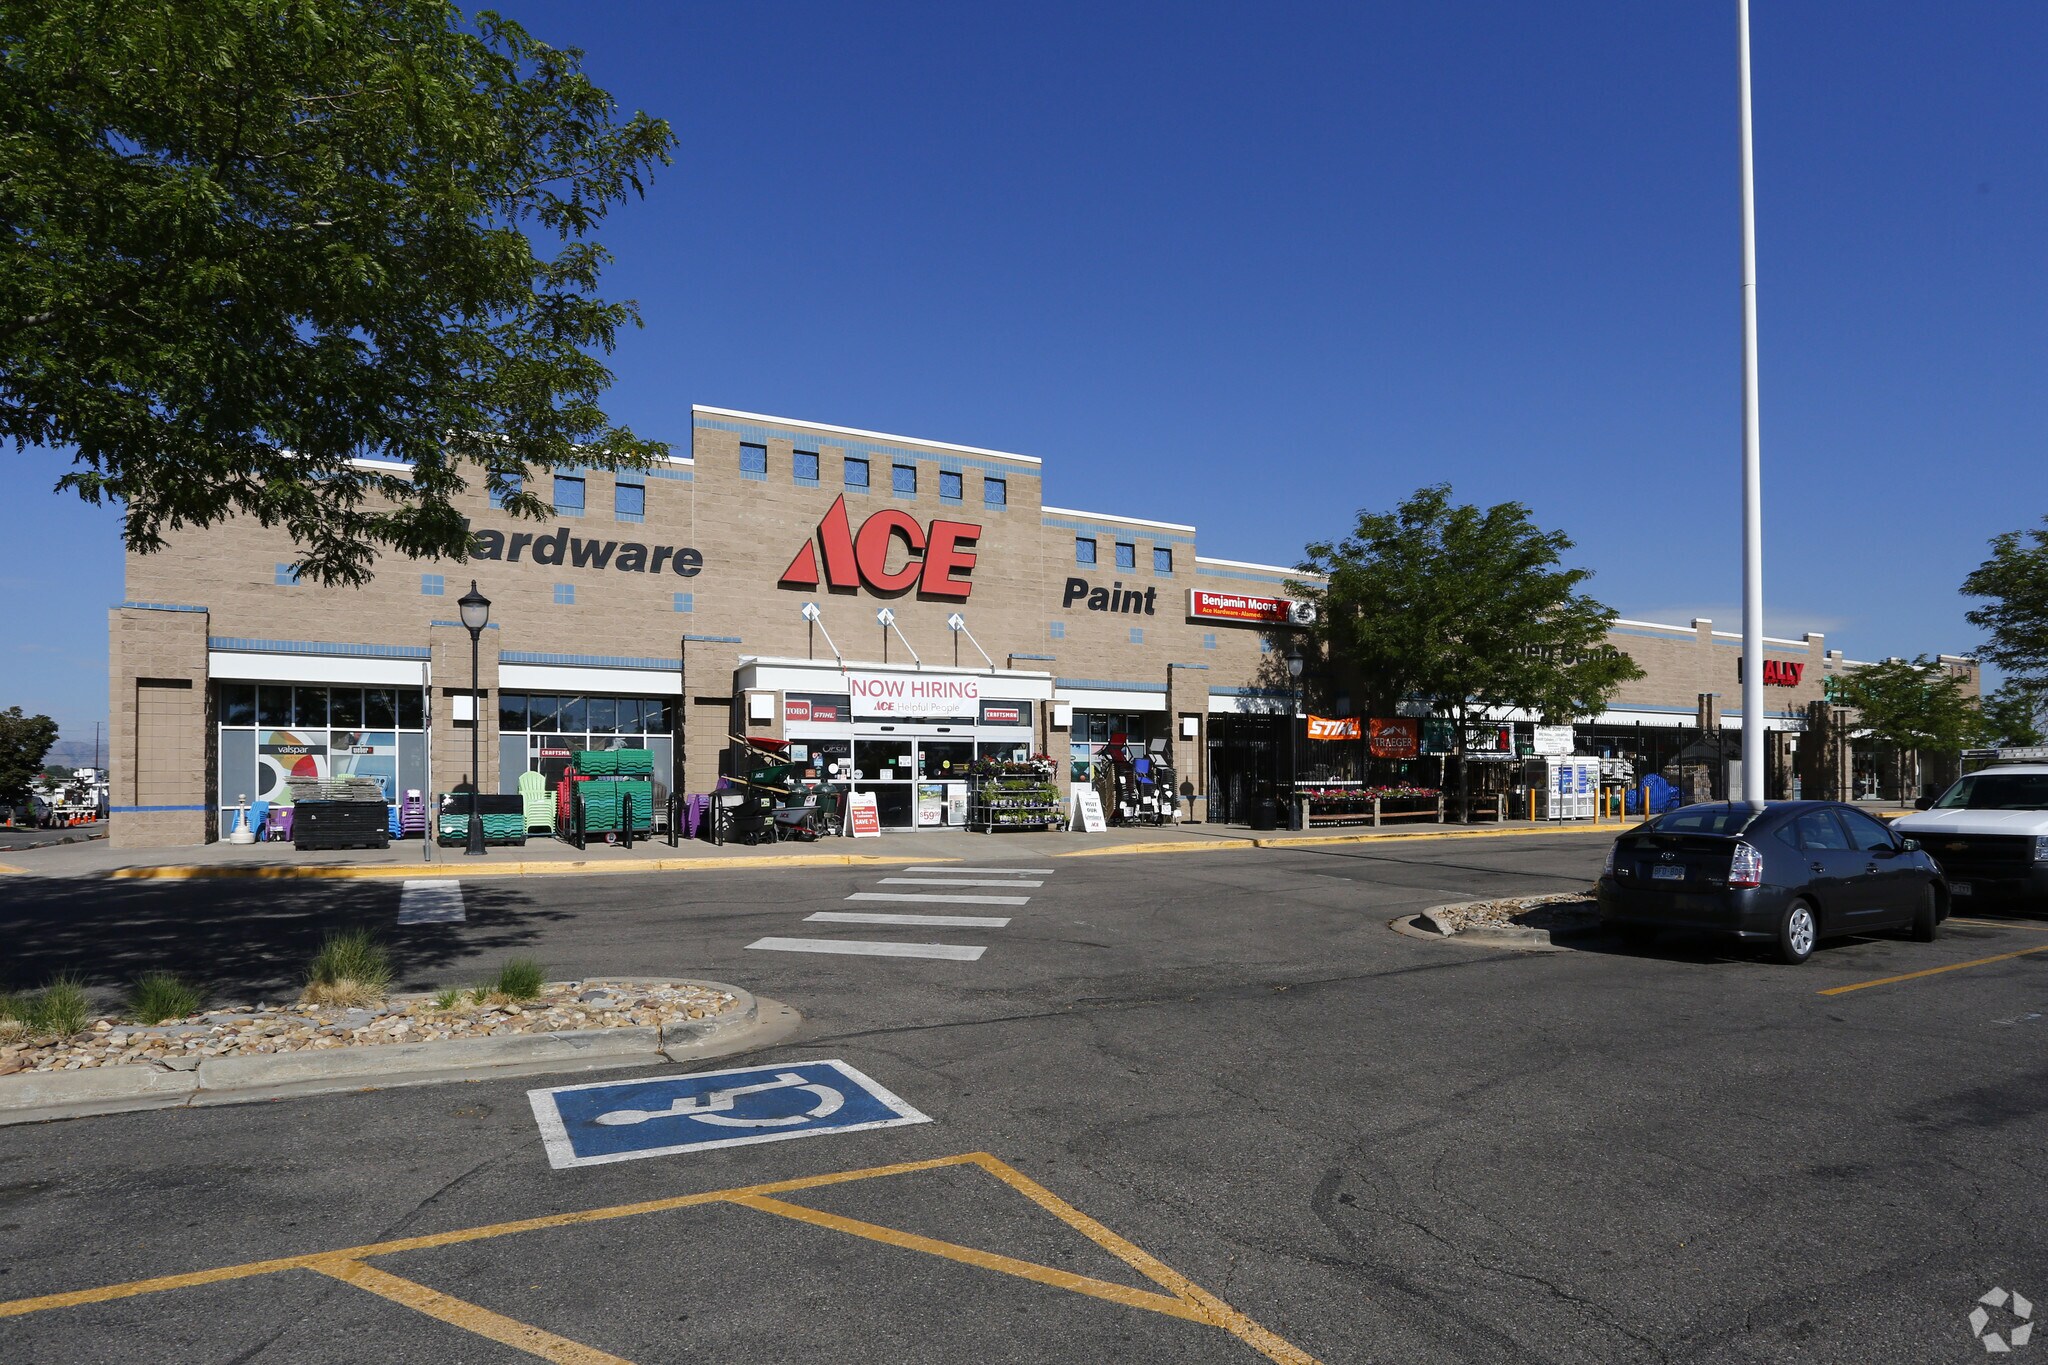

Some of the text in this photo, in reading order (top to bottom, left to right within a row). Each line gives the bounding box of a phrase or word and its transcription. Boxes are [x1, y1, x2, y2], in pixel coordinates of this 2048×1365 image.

[461, 519, 704, 577] ardware
[778, 493, 982, 603] ACE
[1063, 578, 1157, 615] Paint
[1202, 594, 1277, 612] Benjamin Moore
[1213, 608, 1239, 616] Hardware
[1750, 659, 1804, 681] ALLY
[852, 679, 978, 699] NOW HIRING
[786, 707, 808, 715] TORO
[813, 711, 836, 719] STIHL
[873, 701, 960, 714] ACE Helpful People
[1309, 721, 1358, 736] STIHL
[1374, 737, 1412, 747] TRAEGER
[277, 745, 308, 755] valspar
